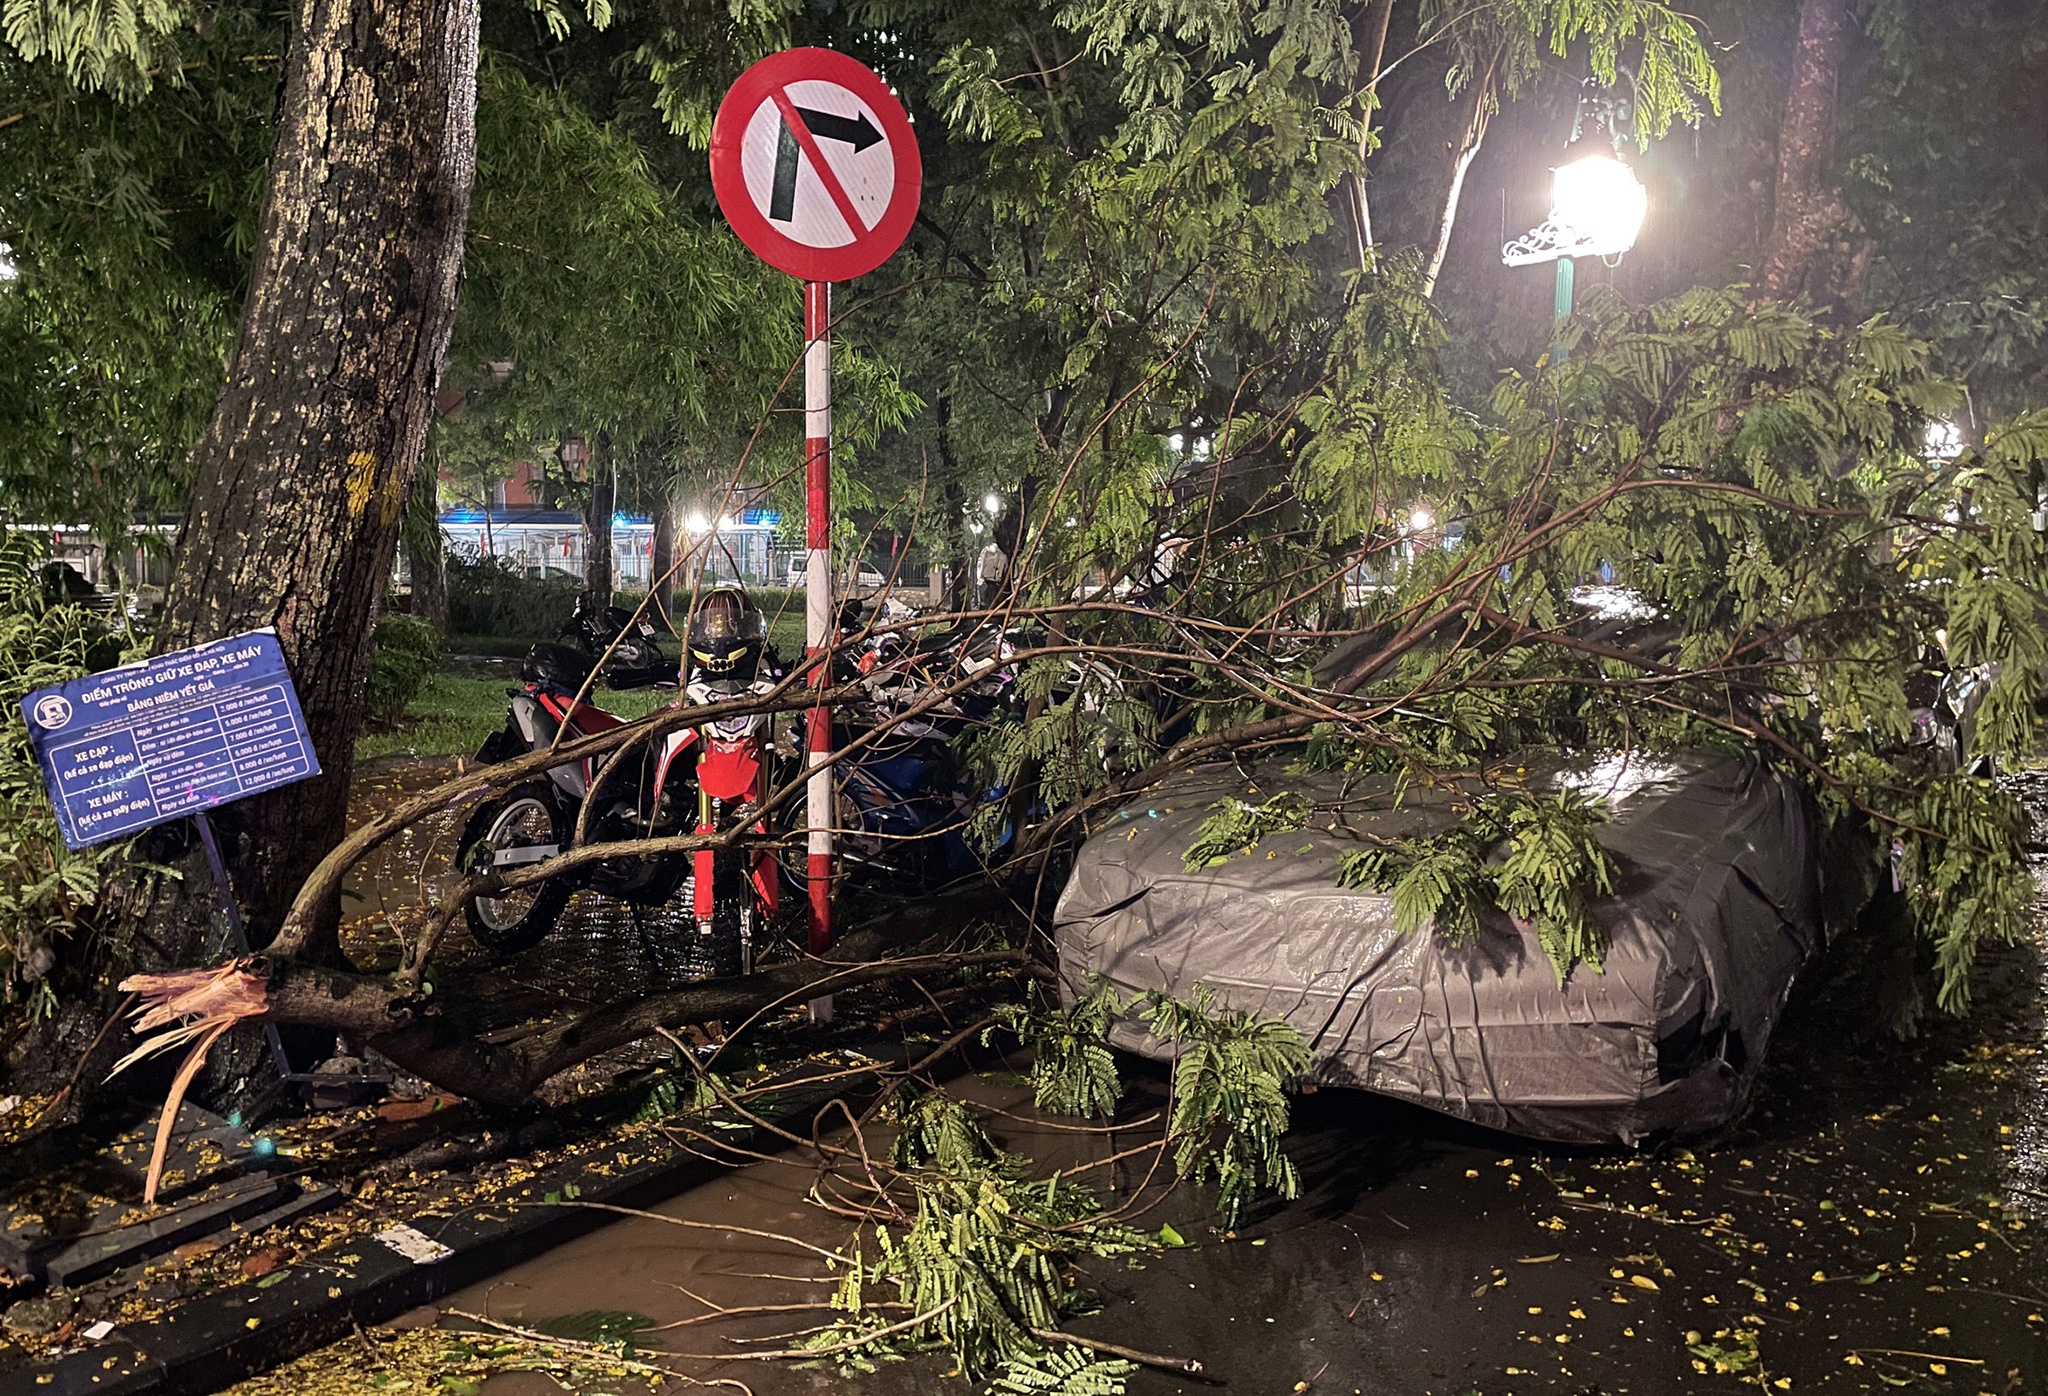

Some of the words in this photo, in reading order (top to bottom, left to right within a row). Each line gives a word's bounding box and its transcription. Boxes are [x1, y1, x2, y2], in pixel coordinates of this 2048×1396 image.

[81, 687, 113, 704] ĐIỂM
[112, 676, 154, 695] TRÔNG
[155, 667, 177, 683] GIỮ
[177, 664, 194, 678] XE
[194, 658, 220, 673] ĐẠP,
[219, 652, 237, 665] XE
[236, 645, 261, 661] MÁY
[126, 697, 154, 713] BẢNG
[154, 690, 179, 705] NIÊM
[178, 683, 197, 697] YẾT
[197, 679, 215, 692] GIÁ
[74, 751, 89, 763] XE
[88, 745, 109, 759] ĐẠP
[88, 764, 98, 772] xe
[98, 759, 114, 770] đạp
[114, 752, 134, 765] điện)
[87, 797, 103, 809] XE
[102, 790, 122, 805] MÁY
[102, 810, 112, 819] xe
[130, 797, 150, 810] điện)
